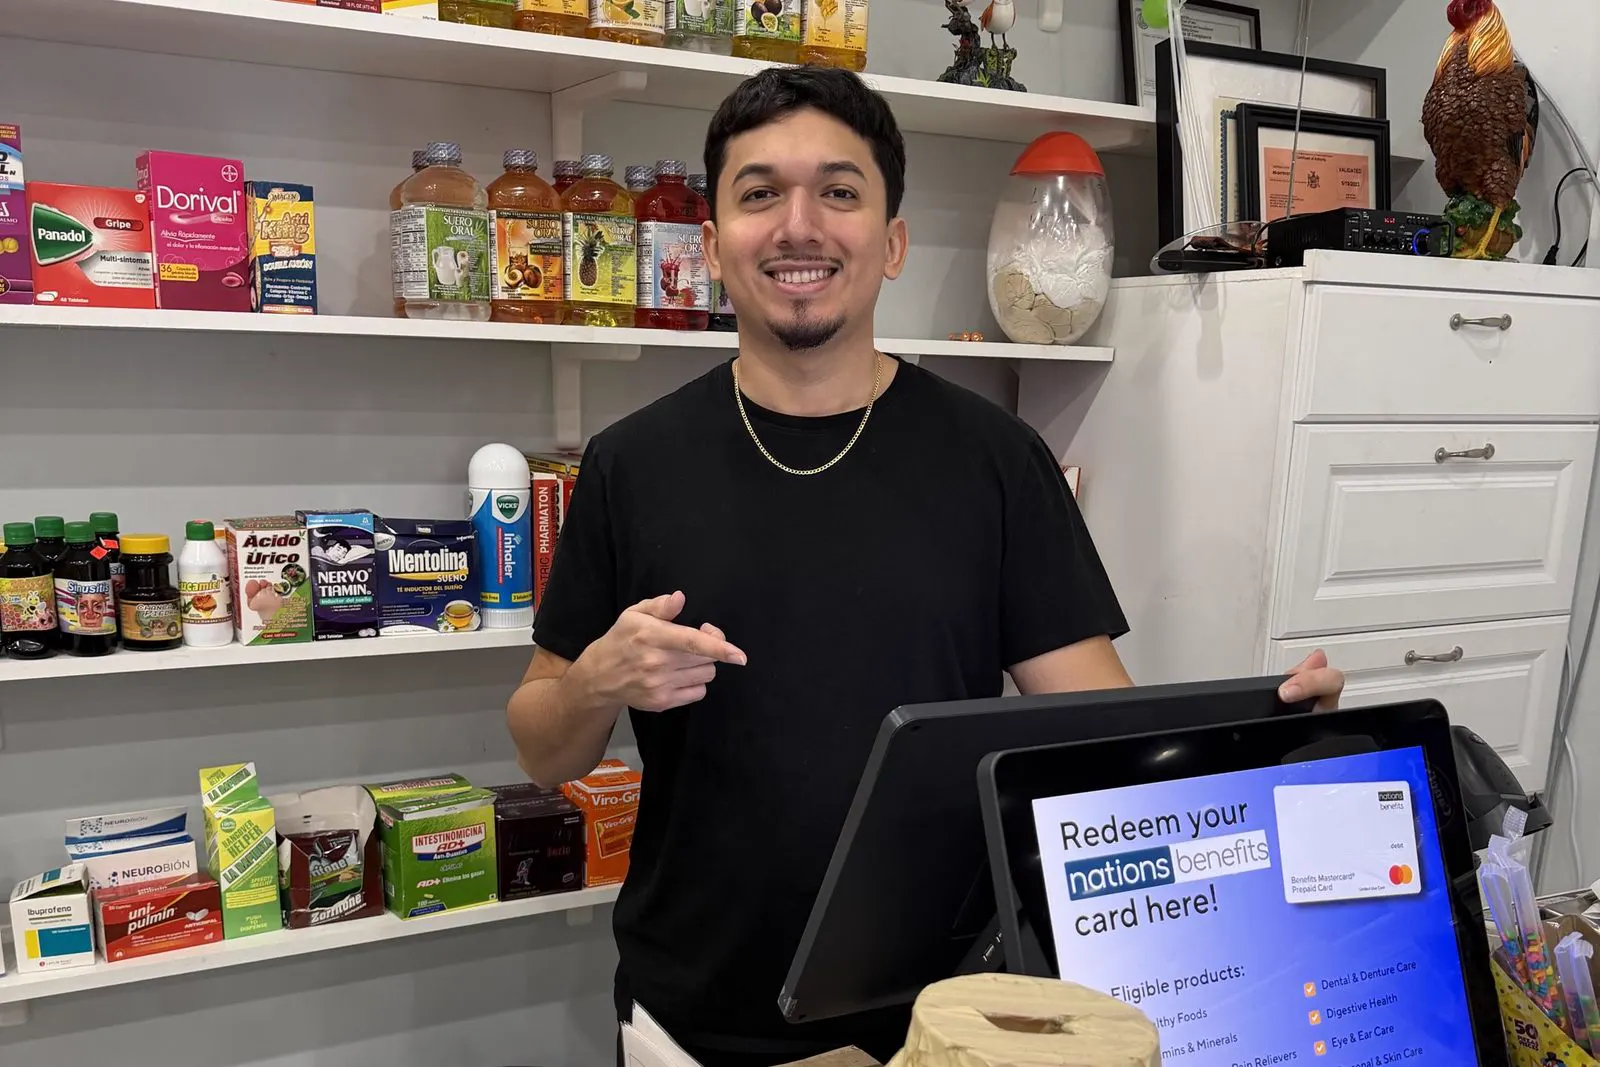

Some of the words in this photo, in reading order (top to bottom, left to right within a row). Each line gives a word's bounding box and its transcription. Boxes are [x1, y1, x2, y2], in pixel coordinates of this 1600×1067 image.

[157, 185, 238, 214] Dorival
[105, 219, 131, 231] Gripe
[443, 215, 472, 227] SUERO
[526, 219, 560, 231] SUERO
[38, 228, 86, 243] Panadol
[261, 220, 310, 244] King
[450, 225, 475, 236] ORAL
[684, 242, 703, 253] ORA
[160, 264, 172, 273] 36
[539, 486, 549, 554] PHARMATON
[243, 530, 301, 548] Ácido
[246, 549, 300, 565] Úrico
[388, 547, 468, 574] Mentolina
[504, 533, 516, 579] Inhaler
[317, 569, 369, 584] NERVO
[67, 580, 110, 594] Sinusitis
[318, 584, 368, 597] TIAMIN
[207, 789, 221, 802] LA
[591, 791, 640, 807] Viro-Gri
[1378, 791, 1404, 801] nations
[1379, 802, 1404, 811] benefits
[604, 815, 634, 829] Viro-Grip
[1060, 815, 1182, 850] Redeem
[1187, 802, 1249, 839] your
[222, 819, 254, 849] HANGOVER
[227, 824, 263, 859] HELPER
[415, 826, 483, 847] INTESTINOMICINA
[1390, 842, 1404, 850] debit
[122, 860, 190, 879] NEUROBIÓN
[311, 858, 347, 877] ritone
[1068, 857, 1171, 894] nations
[1175, 838, 1269, 874] benefits
[222, 867, 240, 884] LA
[416, 877, 441, 889] AD+
[442, 874, 461, 884] Elimina
[1291, 875, 1317, 885] Benefits
[1291, 884, 1317, 895] Prepaid
[1318, 883, 1333, 892] Card
[27, 905, 72, 917] Ibuprofeno
[128, 902, 155, 921] uni-
[311, 893, 362, 924] Zorritone
[1074, 897, 1139, 937] card
[1145, 883, 1219, 924] here!
[1321, 974, 1351, 990] Dental
[1352, 972, 1360, 983] &
[1360, 966, 1395, 982] Denture
[1396, 960, 1417, 973] Care
[1111, 978, 1170, 1004] Eligible
[1174, 964, 1246, 995] products:
[1327, 1001, 1367, 1020] Digestive
[1368, 993, 1398, 1009] Health
[1178, 1008, 1208, 1024] Foods
[1331, 1036, 1349, 1050] Eye
[1349, 1032, 1357, 1043] &
[1358, 1030, 1373, 1042] Ear
[1373, 1024, 1396, 1037] Care
[1514, 1018, 1539, 1040] 50
[1161, 1045, 1186, 1060] mins
[1187, 1043, 1195, 1053] &
[1196, 1033, 1239, 1051] Minerals
[1254, 1051, 1298, 1067] Relievers
[1375, 1055, 1383, 1066] &
[1383, 1051, 1402, 1064] Skin
[1403, 1045, 1424, 1058] Care
